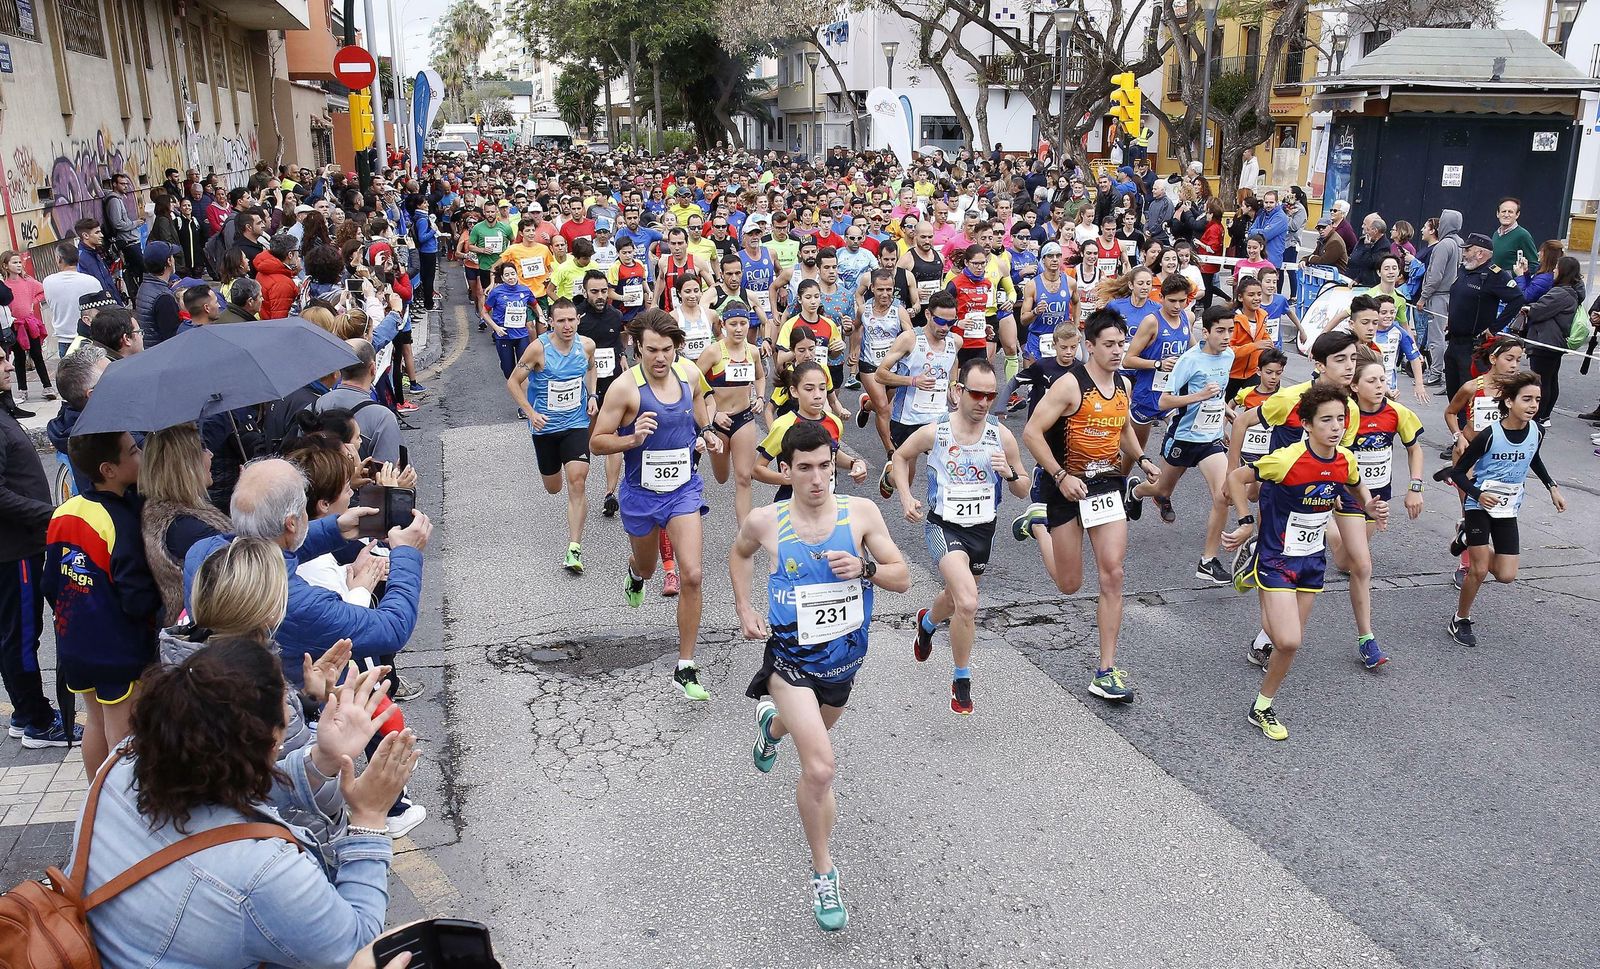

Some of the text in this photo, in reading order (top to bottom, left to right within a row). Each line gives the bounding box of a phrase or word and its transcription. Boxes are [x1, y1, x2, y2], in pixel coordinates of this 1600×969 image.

[746, 268, 770, 280] RCM
[748, 281, 769, 291] 1873
[688, 341, 704, 350] 665
[1161, 340, 1188, 355] RCM
[733, 368, 748, 378] 217
[557, 392, 574, 402] 541
[1205, 413, 1221, 423] 712
[1248, 433, 1267, 443] 266
[1491, 450, 1526, 462] nerja
[654, 467, 679, 479] 362
[946, 460, 988, 481] 2020
[1364, 465, 1387, 477] 832
[956, 503, 980, 515] 211
[1091, 496, 1114, 512] 516
[1297, 529, 1321, 543] 305
[60, 563, 94, 586] Máaga
[815, 605, 847, 626] 231
